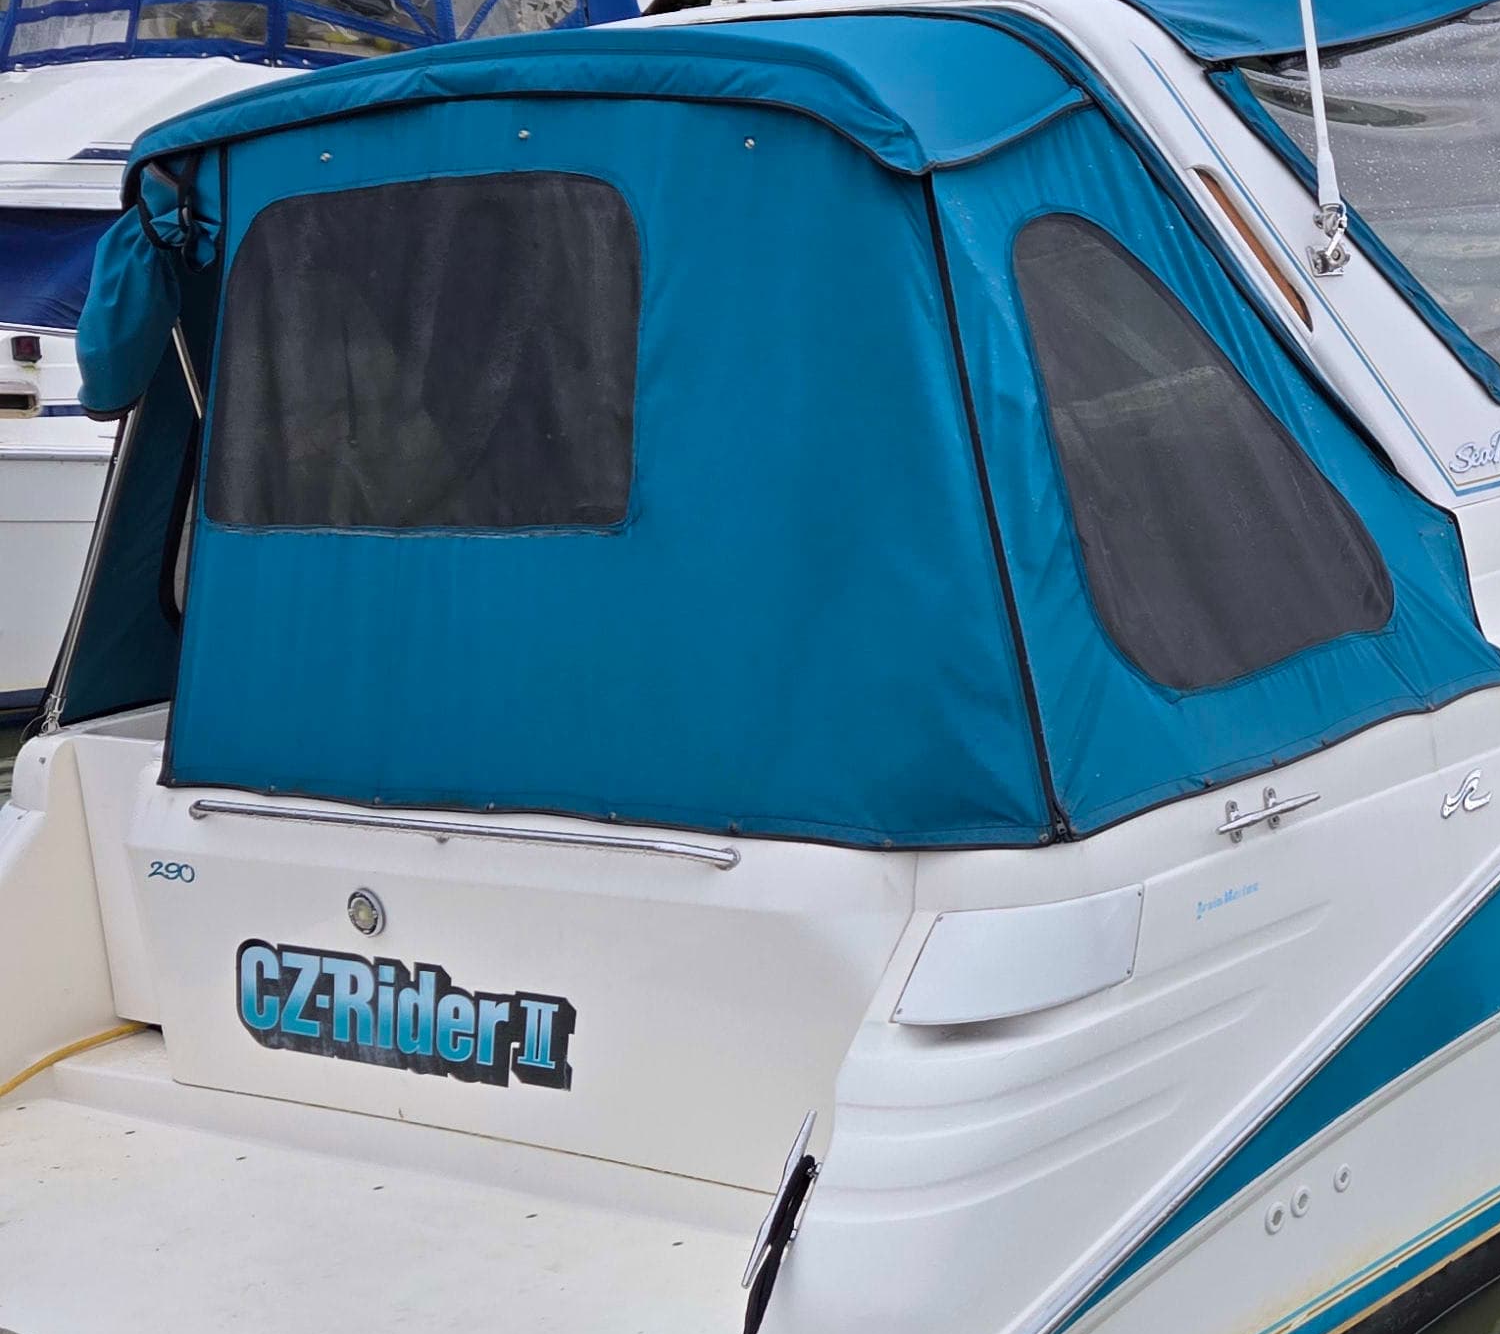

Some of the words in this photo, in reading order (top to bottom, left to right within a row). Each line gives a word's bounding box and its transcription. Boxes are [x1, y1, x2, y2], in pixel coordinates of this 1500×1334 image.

[148, 861, 195, 883] 290
[240, 945, 510, 1067] CZ-Rider
[517, 999, 559, 1069] II
